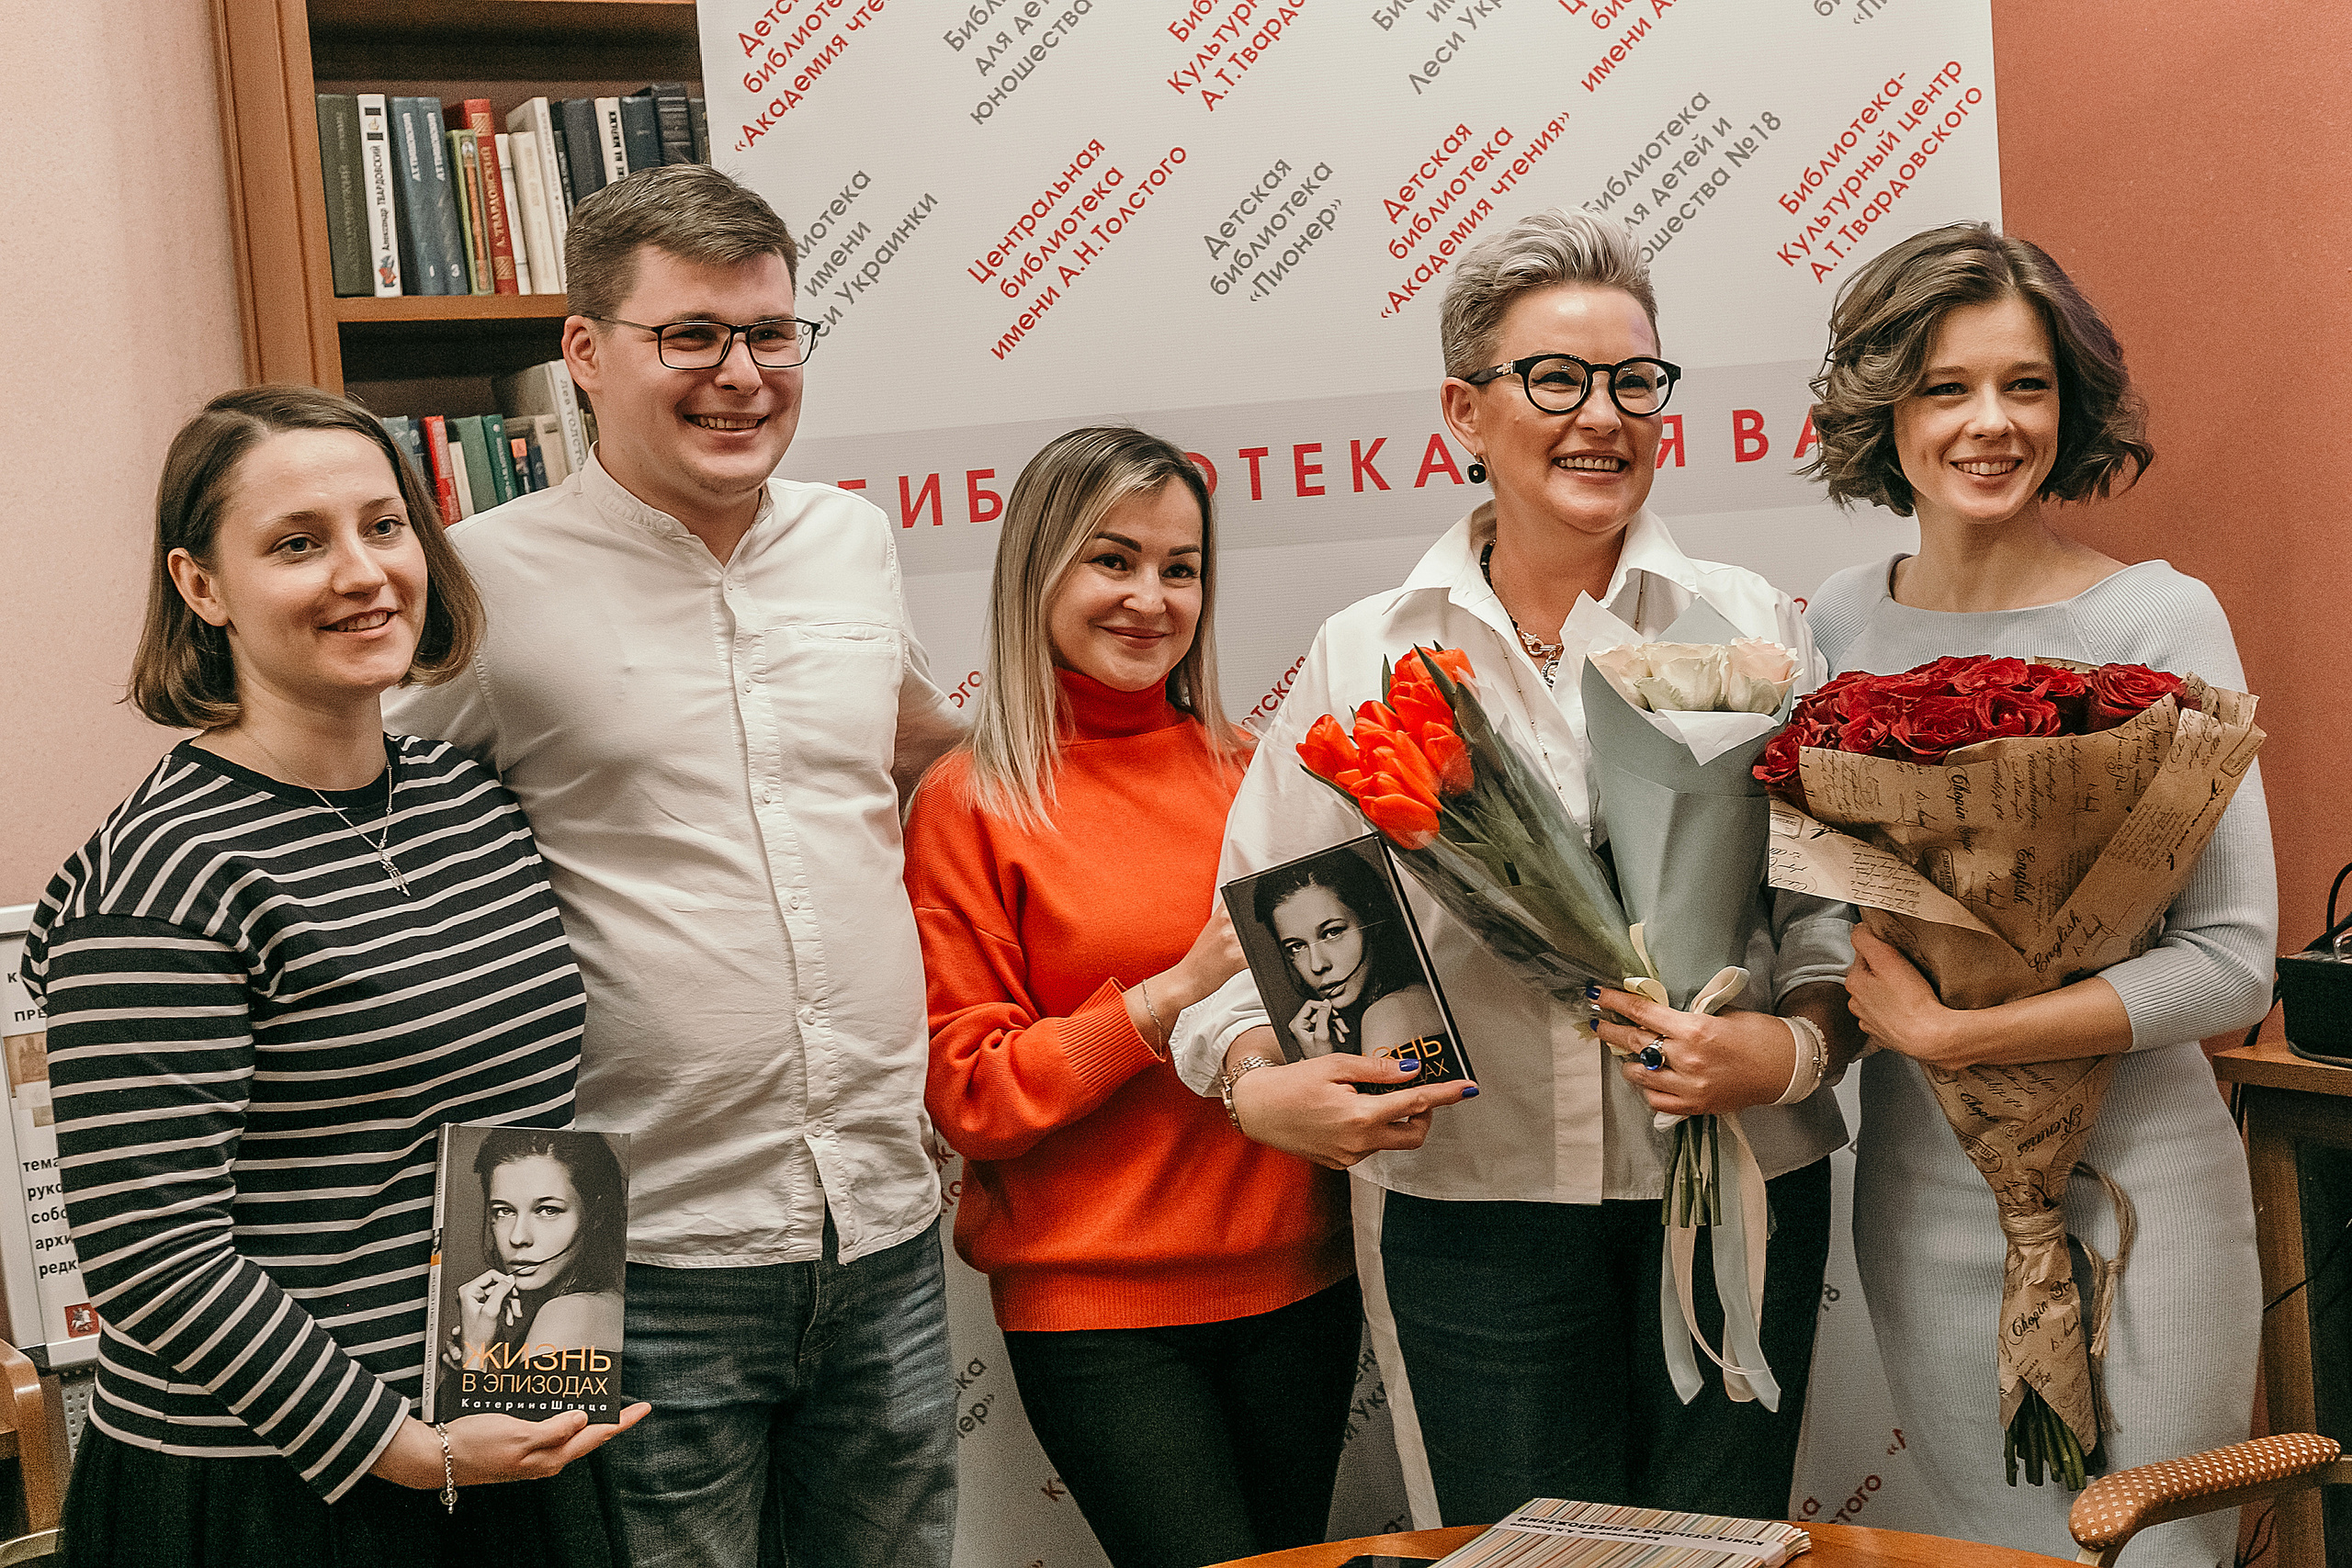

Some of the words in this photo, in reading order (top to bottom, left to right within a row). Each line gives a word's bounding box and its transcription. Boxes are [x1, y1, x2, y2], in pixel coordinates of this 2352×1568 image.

[738, 0, 800, 58] Детс
[943, 0, 1007, 52] Библ
[969, 0, 1093, 125] юношества
[975, 31, 1013, 77] для
[1013, 1, 1051, 36] де
[1167, 0, 1220, 42] Биб
[1580, 17, 1652, 93] имени
[735, 34, 849, 152] «Академия
[845, 0, 893, 31] чте
[1408, 31, 1466, 95] Леси
[1383, 123, 1473, 225] Детская
[1651, 133, 1714, 207] детей
[1712, 117, 1733, 137] и
[1777, 127, 1902, 267] Культурный
[1899, 60, 1962, 133] центр
[1779, 69, 1907, 215] Библиотека-
[967, 138, 1106, 286] Центральная
[1202, 158, 1292, 261] Детская
[1380, 198, 1494, 319] «Академия
[1490, 110, 1570, 197] чтения»
[1388, 126, 1515, 261] библиотека
[1808, 85, 1983, 283] А.Т.Твардовского
[804, 221, 872, 297] имени
[834, 192, 938, 305] Украинки
[990, 285, 1061, 361] имени
[1057, 146, 1187, 283] А.Н.Толстого
[1000, 166, 1125, 298] библиотека
[1212, 162, 1333, 296] библиотека
[1250, 198, 1342, 302] «Пионер»
[1945, 765, 1972, 821] Chopin
[2009, 846, 2036, 905] English
[2028, 909, 2082, 973] English
[462, 1341, 612, 1372] ЖИЗНЬ
[2007, 1300, 2049, 1346] Chopin
[461, 1398, 548, 1411] Катерина
[550, 1400, 607, 1412] Шпица
[462, 1373, 477, 1393] В
[483, 1373, 609, 1398] ЭПИЗОДАХ
[1643, 1529, 1713, 1540] ОТЗЫВОВ
[1717, 1535, 1765, 1547] КНИГА
